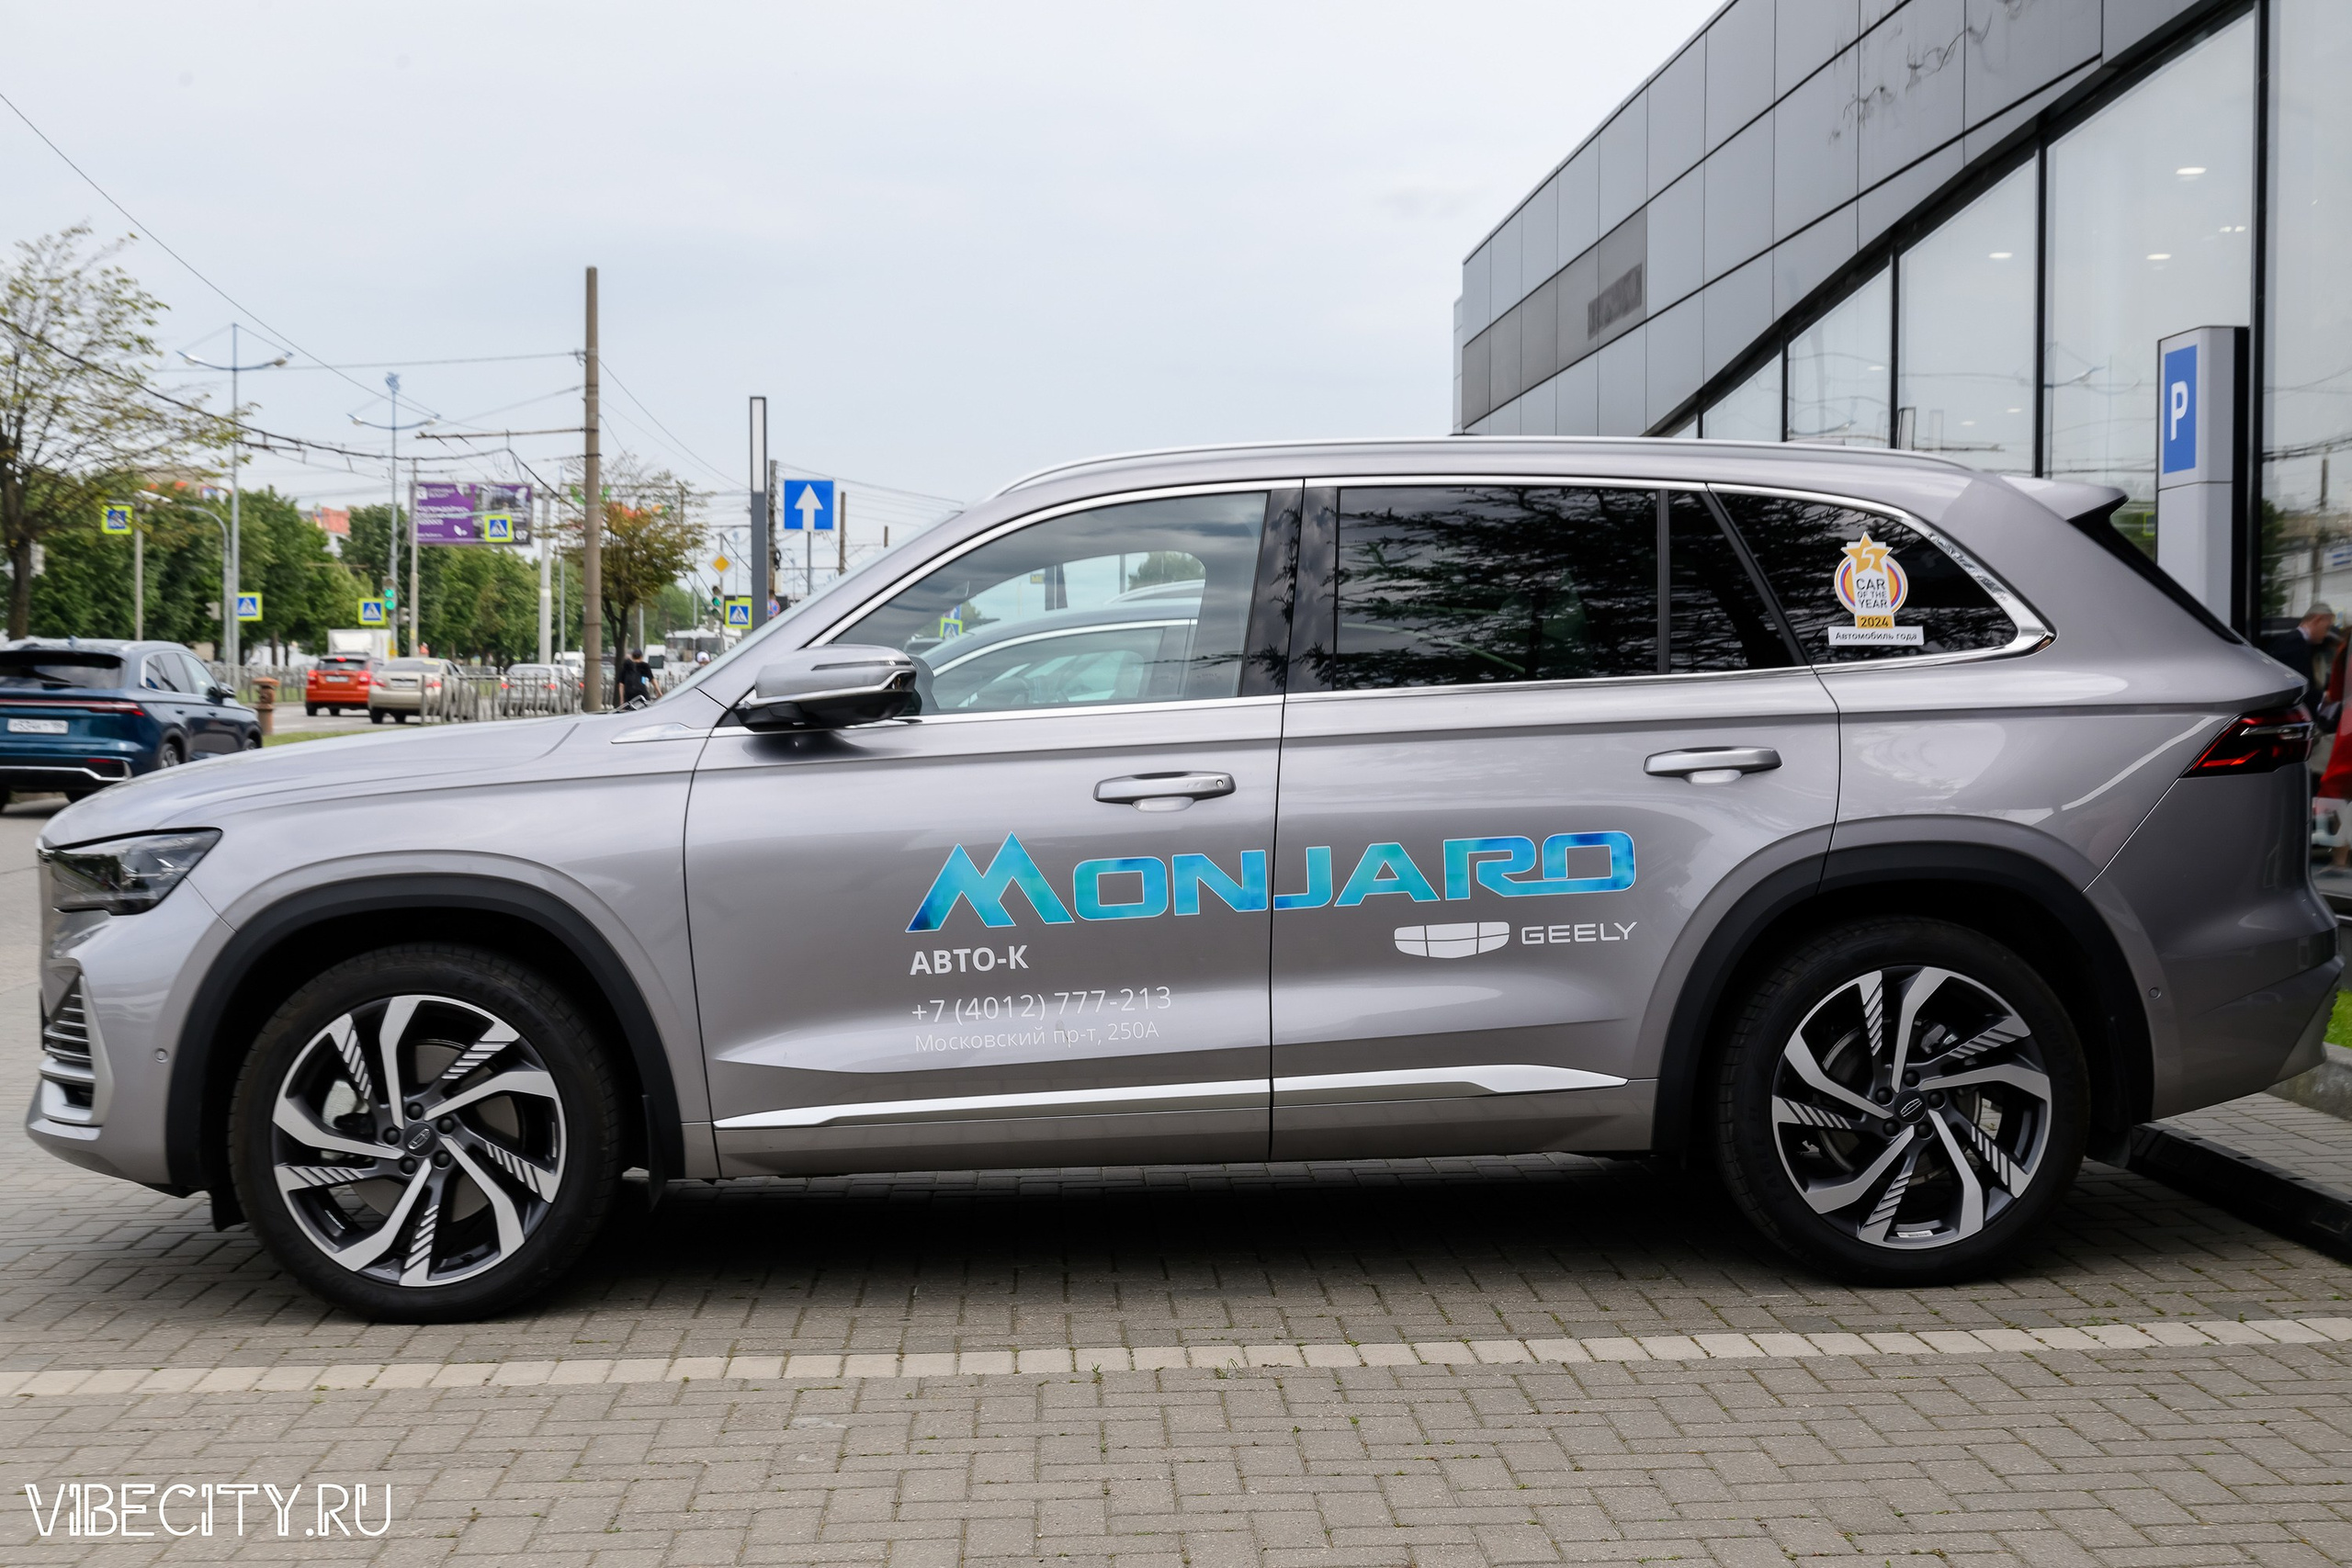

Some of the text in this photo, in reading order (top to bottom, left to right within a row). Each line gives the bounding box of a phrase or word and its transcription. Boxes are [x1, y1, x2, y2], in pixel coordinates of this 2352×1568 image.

[2170, 380, 2189, 441] P
[1856, 578, 1886, 591] CAR
[1859, 599, 1888, 609] YEAR
[1835, 631, 1917, 640] Автомобиль года
[1860, 617, 1889, 627] 2024
[905, 830, 1636, 932] MONJARO
[1521, 921, 1637, 945] GEELY
[910, 944, 1029, 976] АВТО-К
[911, 986, 1171, 1026] +7 (4012) 777-213
[915, 1025, 1045, 1052] Московский
[1107, 1021, 1159, 1041] 250А
